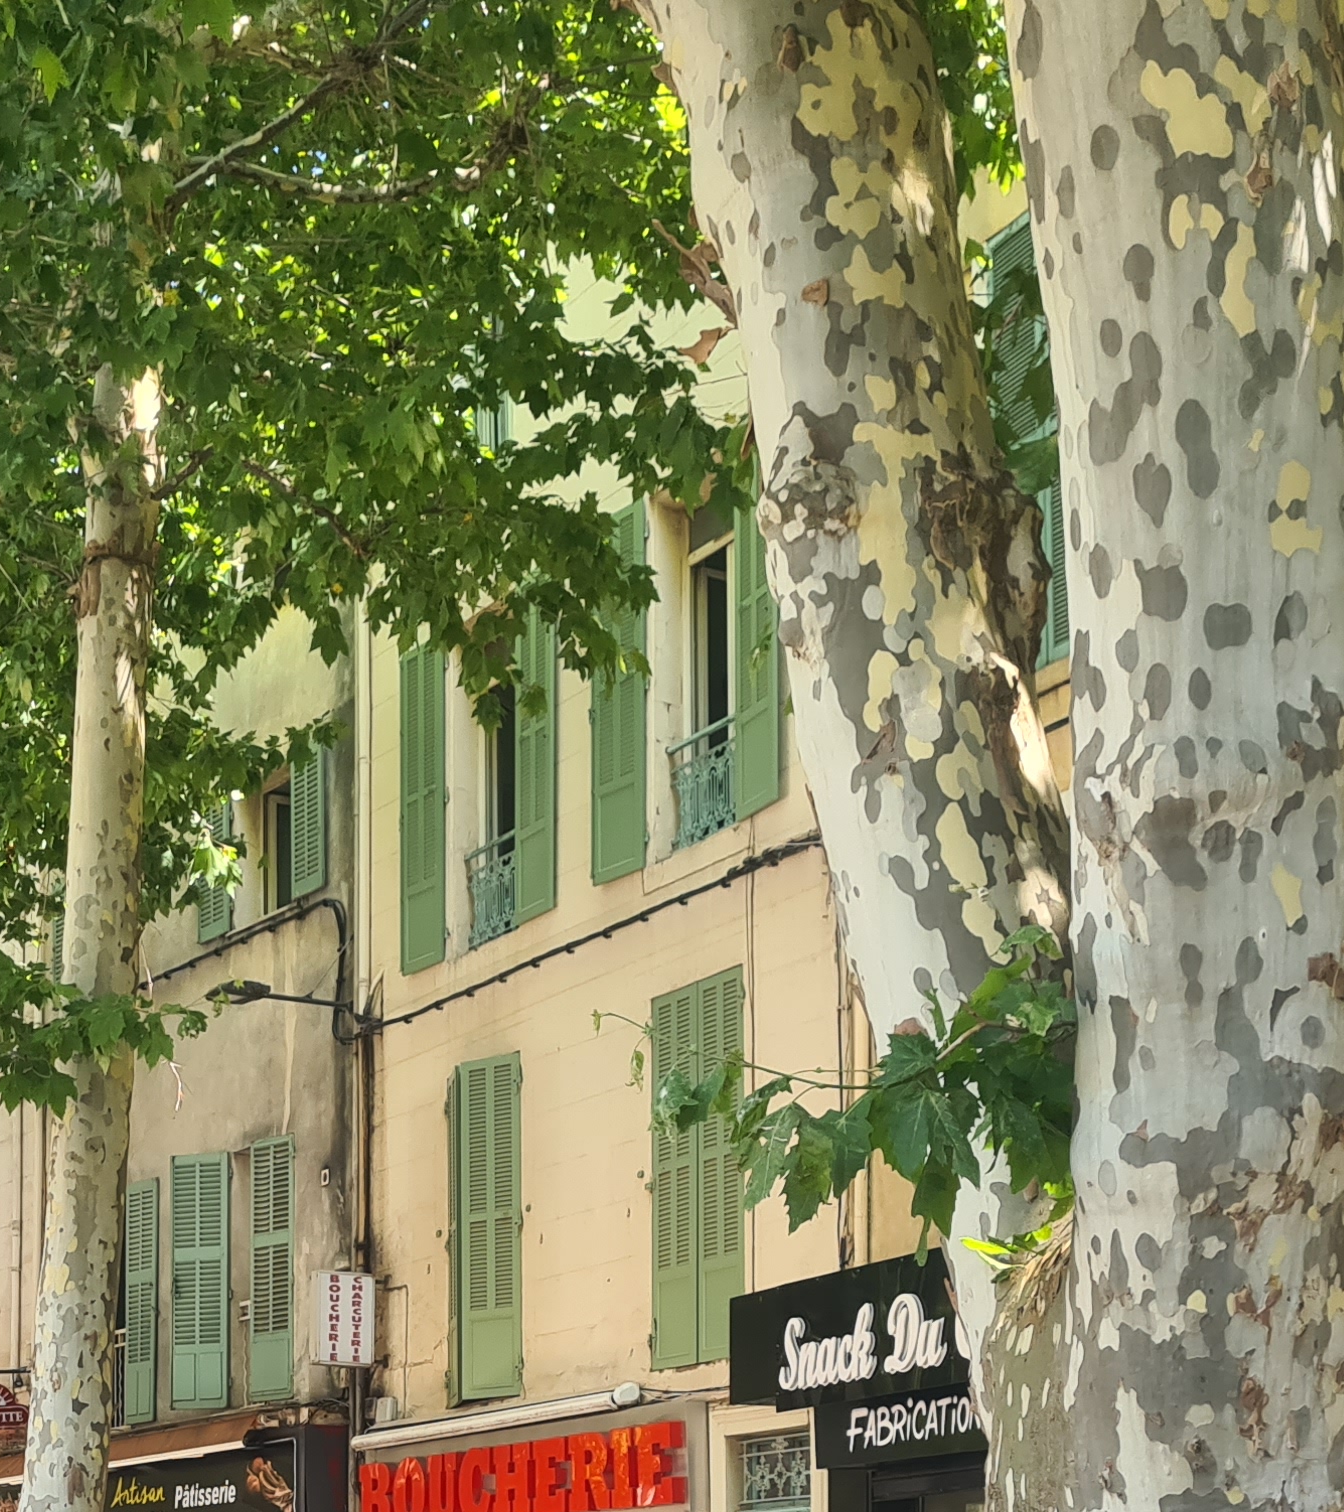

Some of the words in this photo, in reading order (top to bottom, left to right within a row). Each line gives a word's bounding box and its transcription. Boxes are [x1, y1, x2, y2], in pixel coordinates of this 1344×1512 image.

[328, 1274, 341, 1362] BOUCHERIE
[351, 1276, 363, 1363] CHARCUTERIE
[778, 1302, 877, 1390] Snack
[884, 1293, 947, 1374] Du
[110, 1476, 166, 1508] Artisan
[174, 1479, 237, 1509] Pâtisserie
